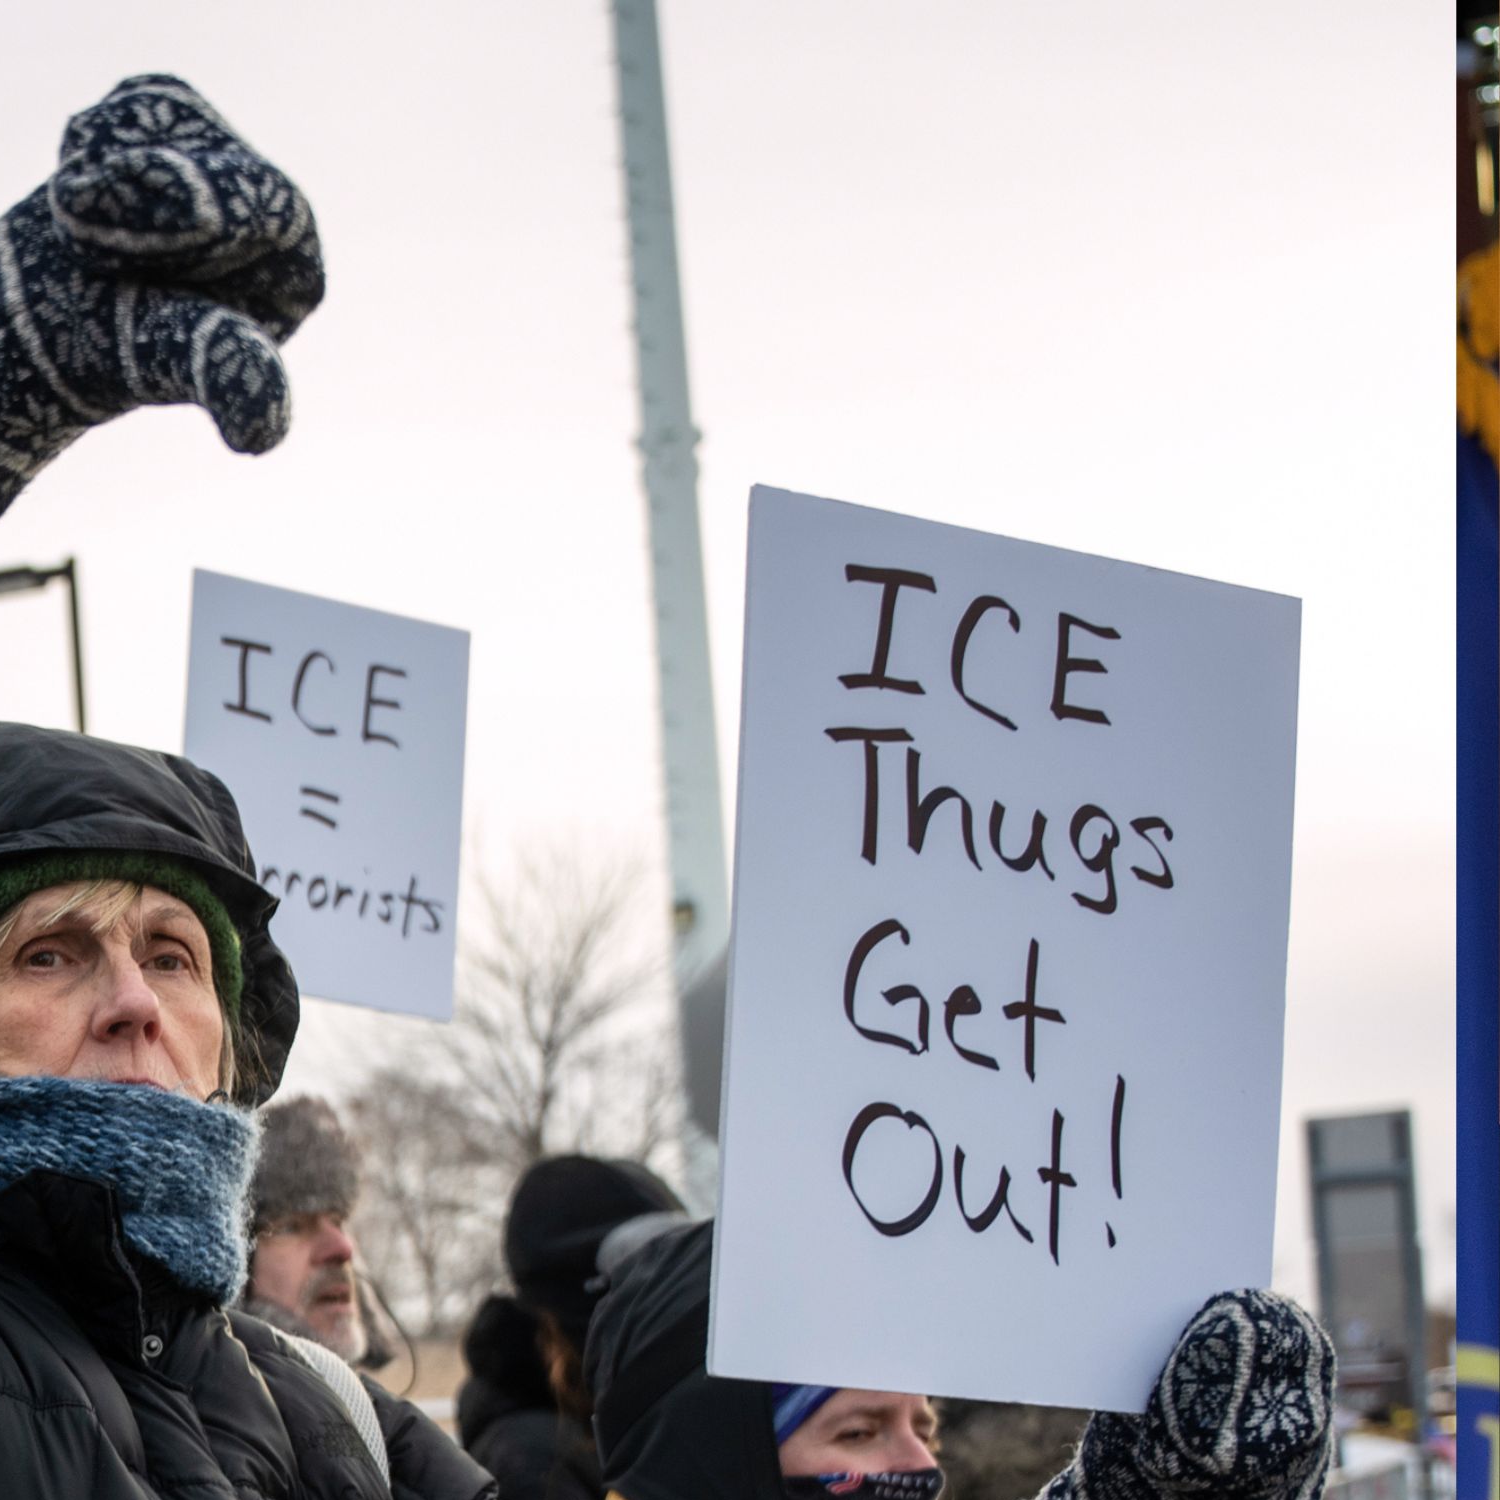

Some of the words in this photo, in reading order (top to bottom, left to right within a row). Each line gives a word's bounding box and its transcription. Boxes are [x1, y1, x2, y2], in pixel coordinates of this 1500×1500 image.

[220, 636, 408, 749] ICE
[838, 563, 1121, 731] ICE
[259, 865, 444, 939] rrorists
[824, 726, 1175, 914] Thugs
[843, 918, 1067, 1082] Get
[842, 1073, 1128, 1266] Out!
